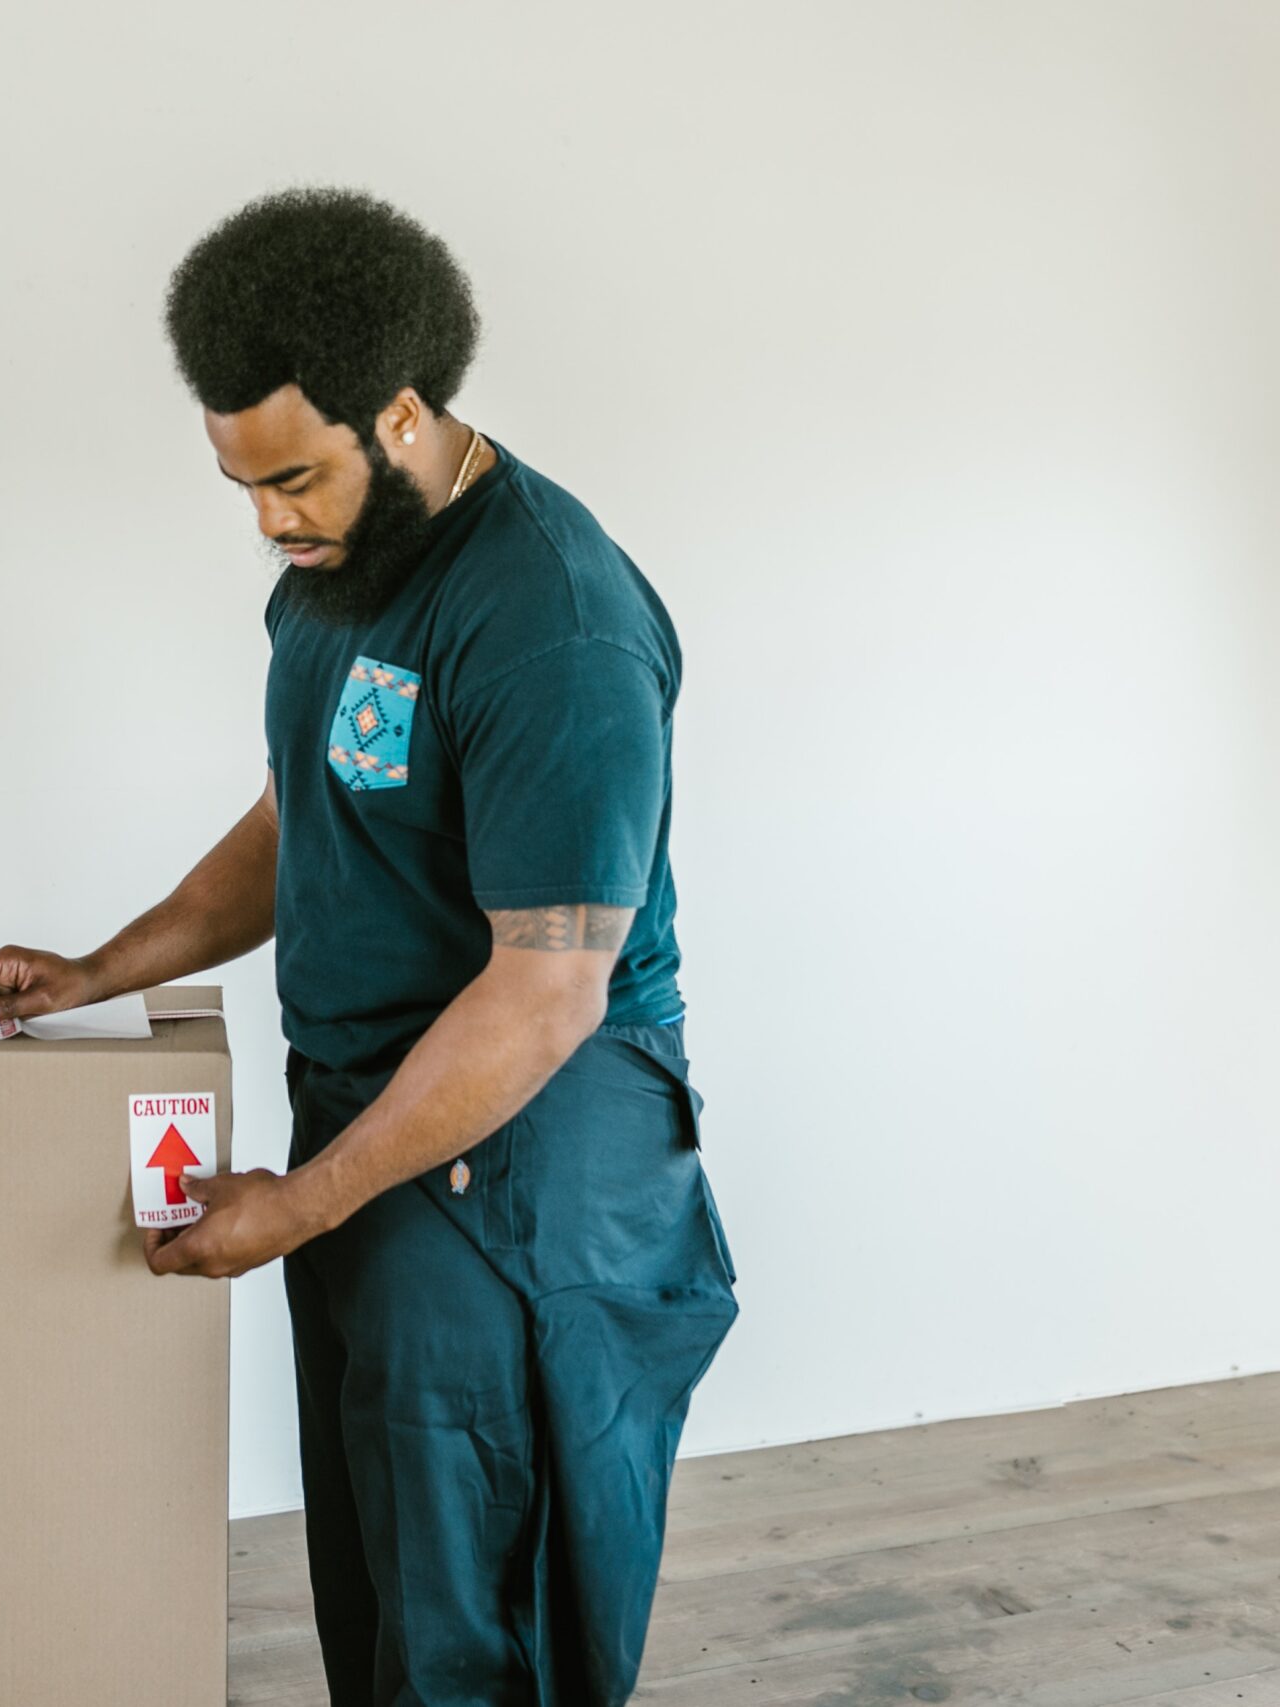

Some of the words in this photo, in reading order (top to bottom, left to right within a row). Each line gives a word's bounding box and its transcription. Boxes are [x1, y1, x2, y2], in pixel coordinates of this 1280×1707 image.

[133, 1098, 209, 1116] CAUTION
[139, 1210, 168, 1221] THIS
[171, 1206, 198, 1220] SIDE
